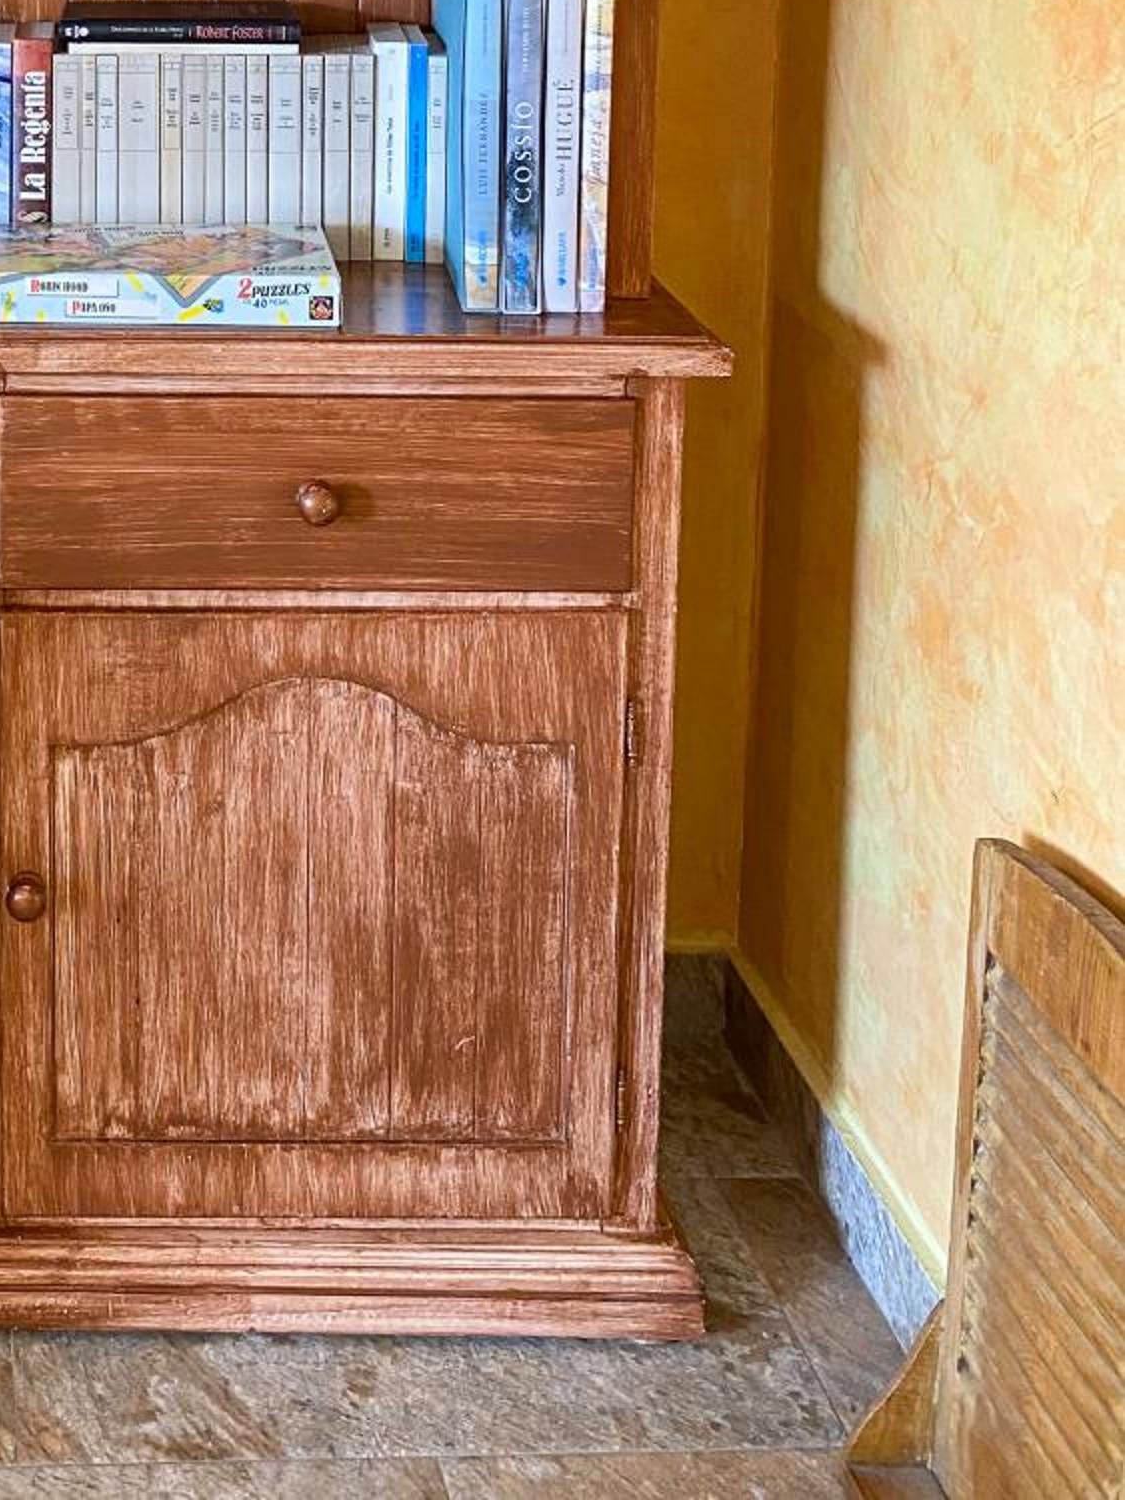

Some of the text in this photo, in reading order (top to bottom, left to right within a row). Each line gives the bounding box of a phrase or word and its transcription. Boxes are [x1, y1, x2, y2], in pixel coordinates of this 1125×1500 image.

[196, 25, 230, 38] ROBERT
[232, 25, 264, 41] FOSTER
[19, 71, 51, 200] La Regenta
[552, 79, 574, 161] HUGUÉ
[512, 101, 533, 204] COSSÍO
[237, 277, 311, 300] 2 PUZZLES
[252, 298, 268, 309] 40
